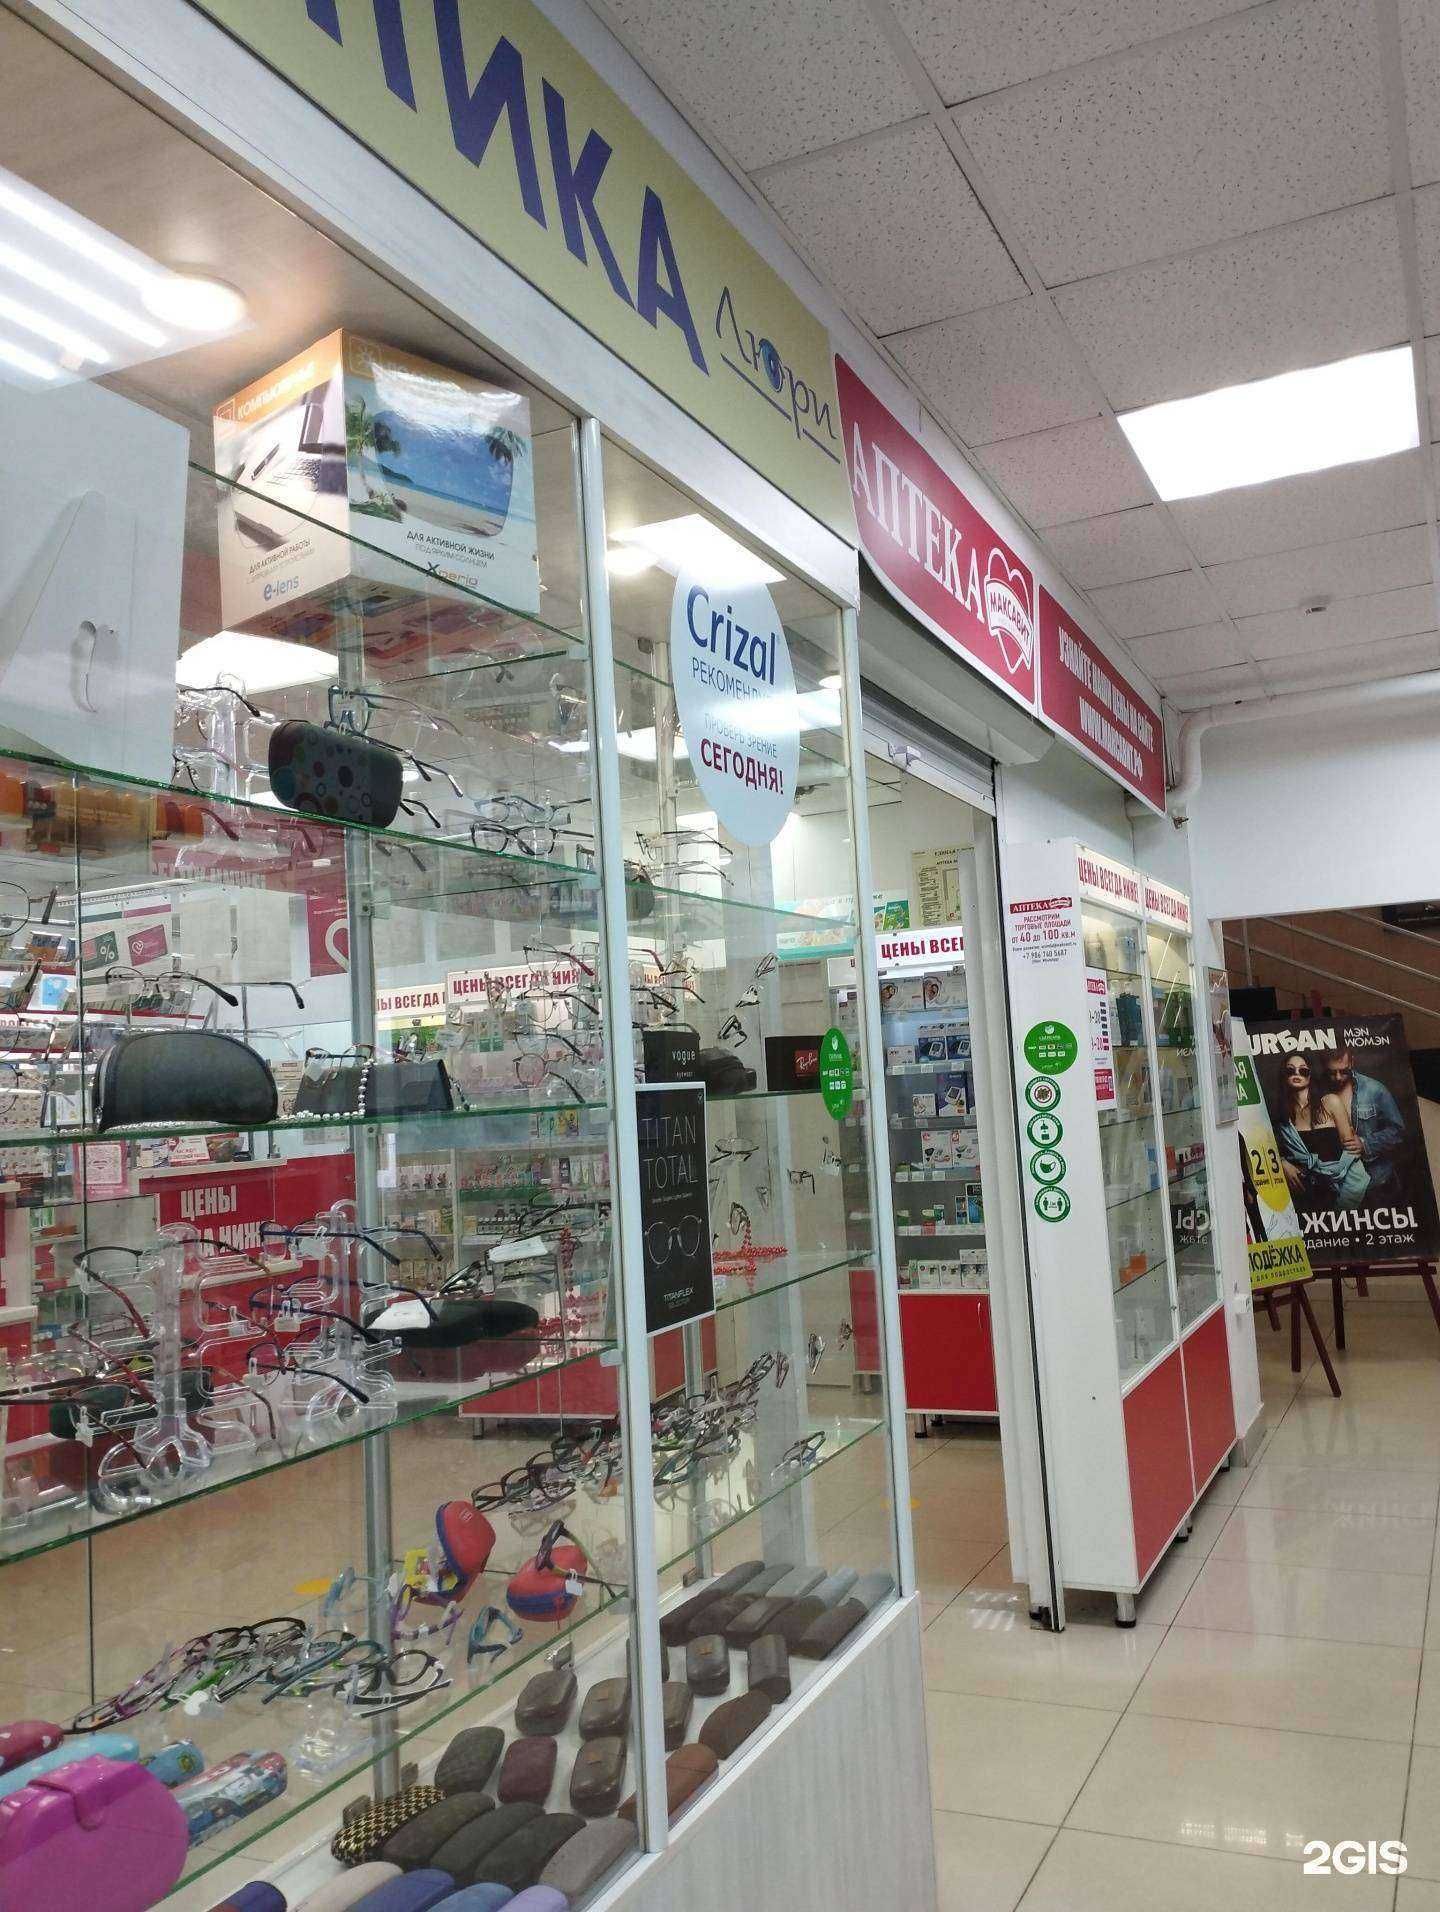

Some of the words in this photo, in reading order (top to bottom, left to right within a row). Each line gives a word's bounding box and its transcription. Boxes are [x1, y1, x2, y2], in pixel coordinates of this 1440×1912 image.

[852, 420, 985, 624] АПТЕКА
[406, 530, 424, 542] ДЛЯ
[425, 535, 467, 553] АКТИВНОЙ
[468, 547, 496, 561] ЖИЗНИ
[990, 591, 1031, 646] МАКСАВИТ
[687, 584, 777, 686] Crizal
[700, 737, 785, 794] СЕГОДНЯ!
[1077, 857, 1099, 887] ЦЕНЫ
[1099, 866, 1122, 898] ВСЕГДА
[1012, 901, 1049, 913] АПТЕКА
[881, 942, 926, 960] ЦЕНЫ
[1020, 931, 1031, 943] 40
[1042, 928, 1059, 941] 100
[395, 992, 440, 1009] ВСЕГДА
[672, 1050, 696, 1066] vogue
[641, 1115, 697, 1149] TITAN
[642, 1153, 699, 1191] TOTAL
[1251, 1149, 1265, 1176] 2
[1267, 1148, 1279, 1174] 3
[181, 1185, 238, 1221] ЦЕНЫ
[1304, 1236, 1351, 1251] дание
[1365, 1233, 1375, 1246] 2
[1378, 1232, 1416, 1246] этаж
